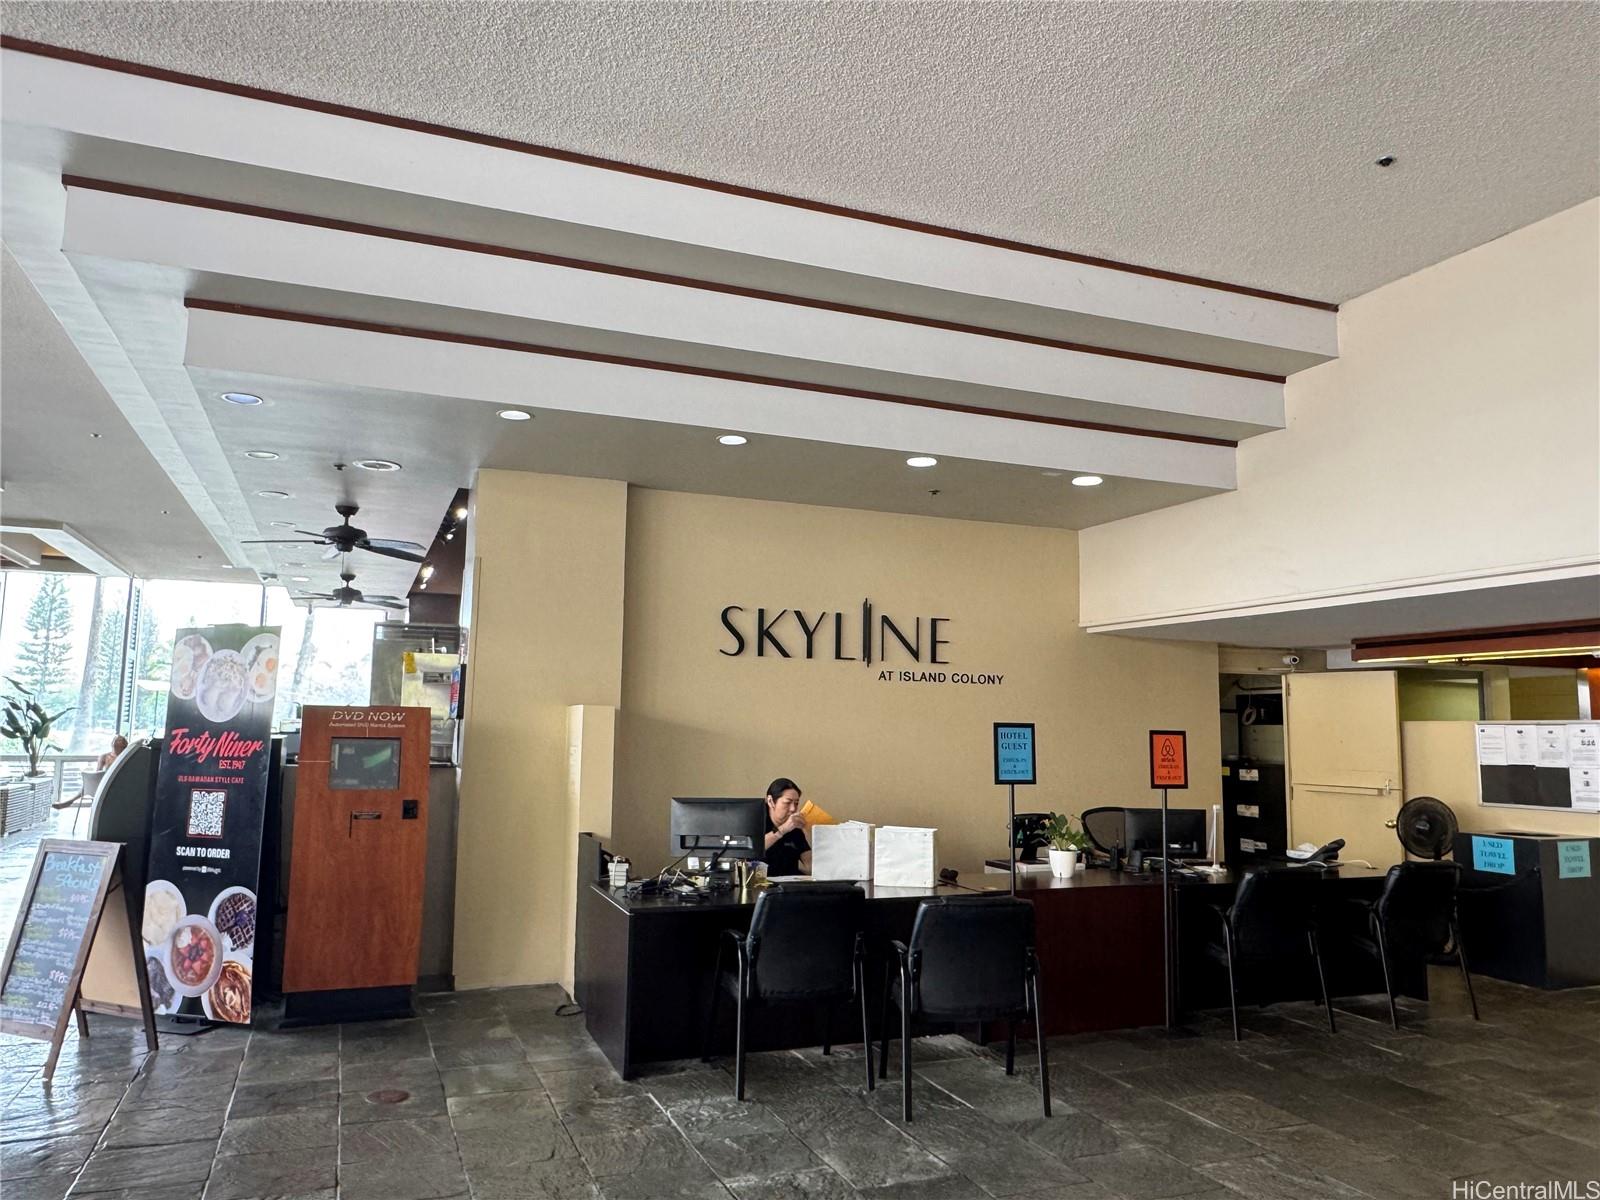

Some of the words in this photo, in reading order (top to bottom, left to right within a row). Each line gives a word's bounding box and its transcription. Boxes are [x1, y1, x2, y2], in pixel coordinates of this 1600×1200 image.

[719, 598, 951, 667] SKYLINE
[878, 671, 894, 681] AT
[899, 671, 947, 683] ISLAND
[951, 673, 1004, 685] COLONY
[332, 711, 365, 721] DVD
[368, 712, 405, 722] NOW
[1000, 732, 1028, 740] HOTEL
[170, 728, 216, 763] Forty
[212, 731, 264, 758] Niner
[1001, 742, 1028, 750] GUEST
[176, 846, 195, 857] SCAN
[197, 847, 206, 858] TO
[207, 848, 231, 859] ORDER
